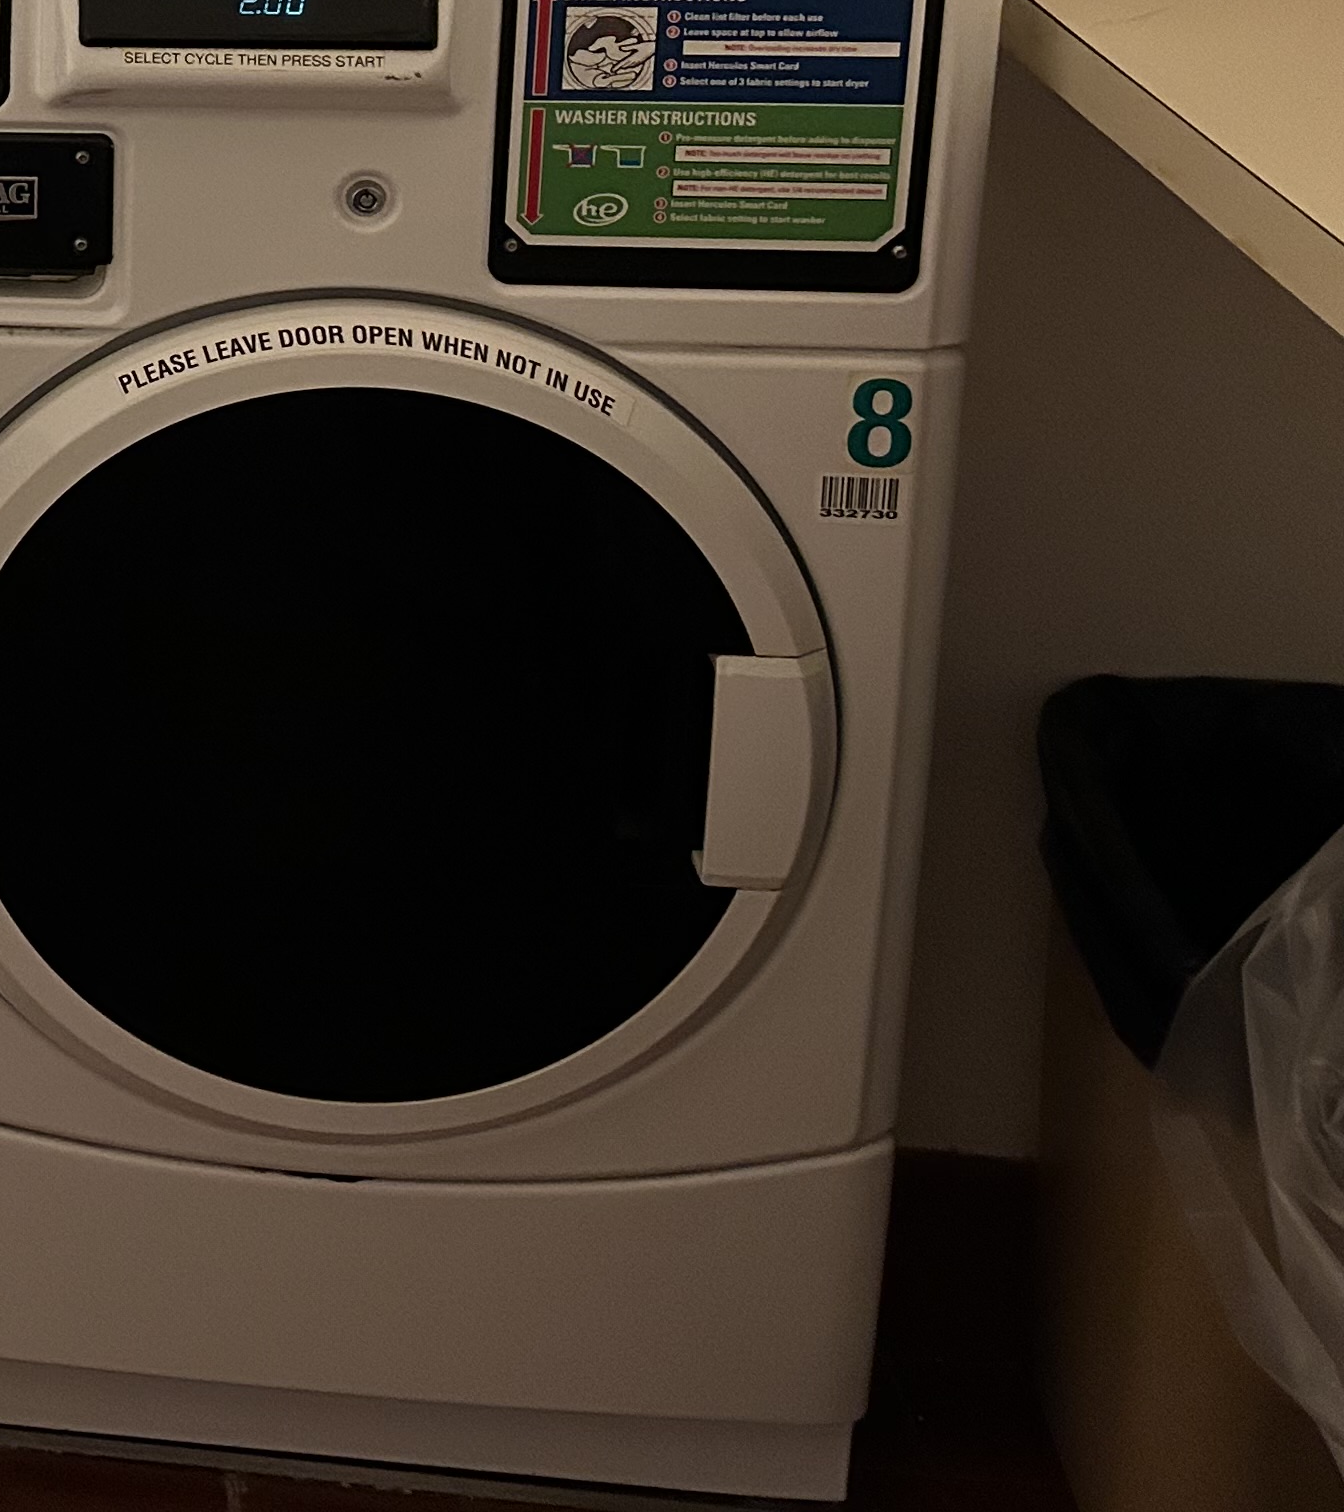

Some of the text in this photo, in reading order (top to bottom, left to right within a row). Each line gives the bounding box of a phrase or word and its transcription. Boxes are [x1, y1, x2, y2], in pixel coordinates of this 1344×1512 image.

[684, 11, 710, 21] Clean
[752, 11, 781, 22] before
[783, 13, 806, 22] each
[807, 14, 824, 22] use
[683, 28, 710, 37] Leave
[711, 29, 738, 38] space
[740, 29, 750, 37] at
[751, 29, 766, 38] top
[767, 29, 776, 37] to
[777, 28, 804, 37] allow
[805, 28, 839, 37] airflow
[124, 52, 384, 68] SELECT CYCLE THEN PRESS START
[681, 61, 706, 69] Insert
[708, 61, 748, 70] Hercules
[750, 61, 777, 70] Smart
[778, 62, 800, 70] Card
[680, 76, 709, 86] Select
[710, 78, 726, 86] one
[728, 77, 737, 86] of
[738, 77, 745, 86] 3
[746, 77, 772, 86] fabric
[774, 78, 810, 88] settings
[822, 79, 844, 87] start
[845, 78, 869, 88] dryer
[555, 109, 757, 127] WASHER INSTRUCTIONS
[766, 201, 788, 210] Card
[670, 212, 698, 221] Select
[118, 324, 616, 416] PLEASE LEAVE DOOR OPEN WHEN NOT IN USE
[847, 377, 913, 468] 8
[819, 508, 898, 519] 332730
